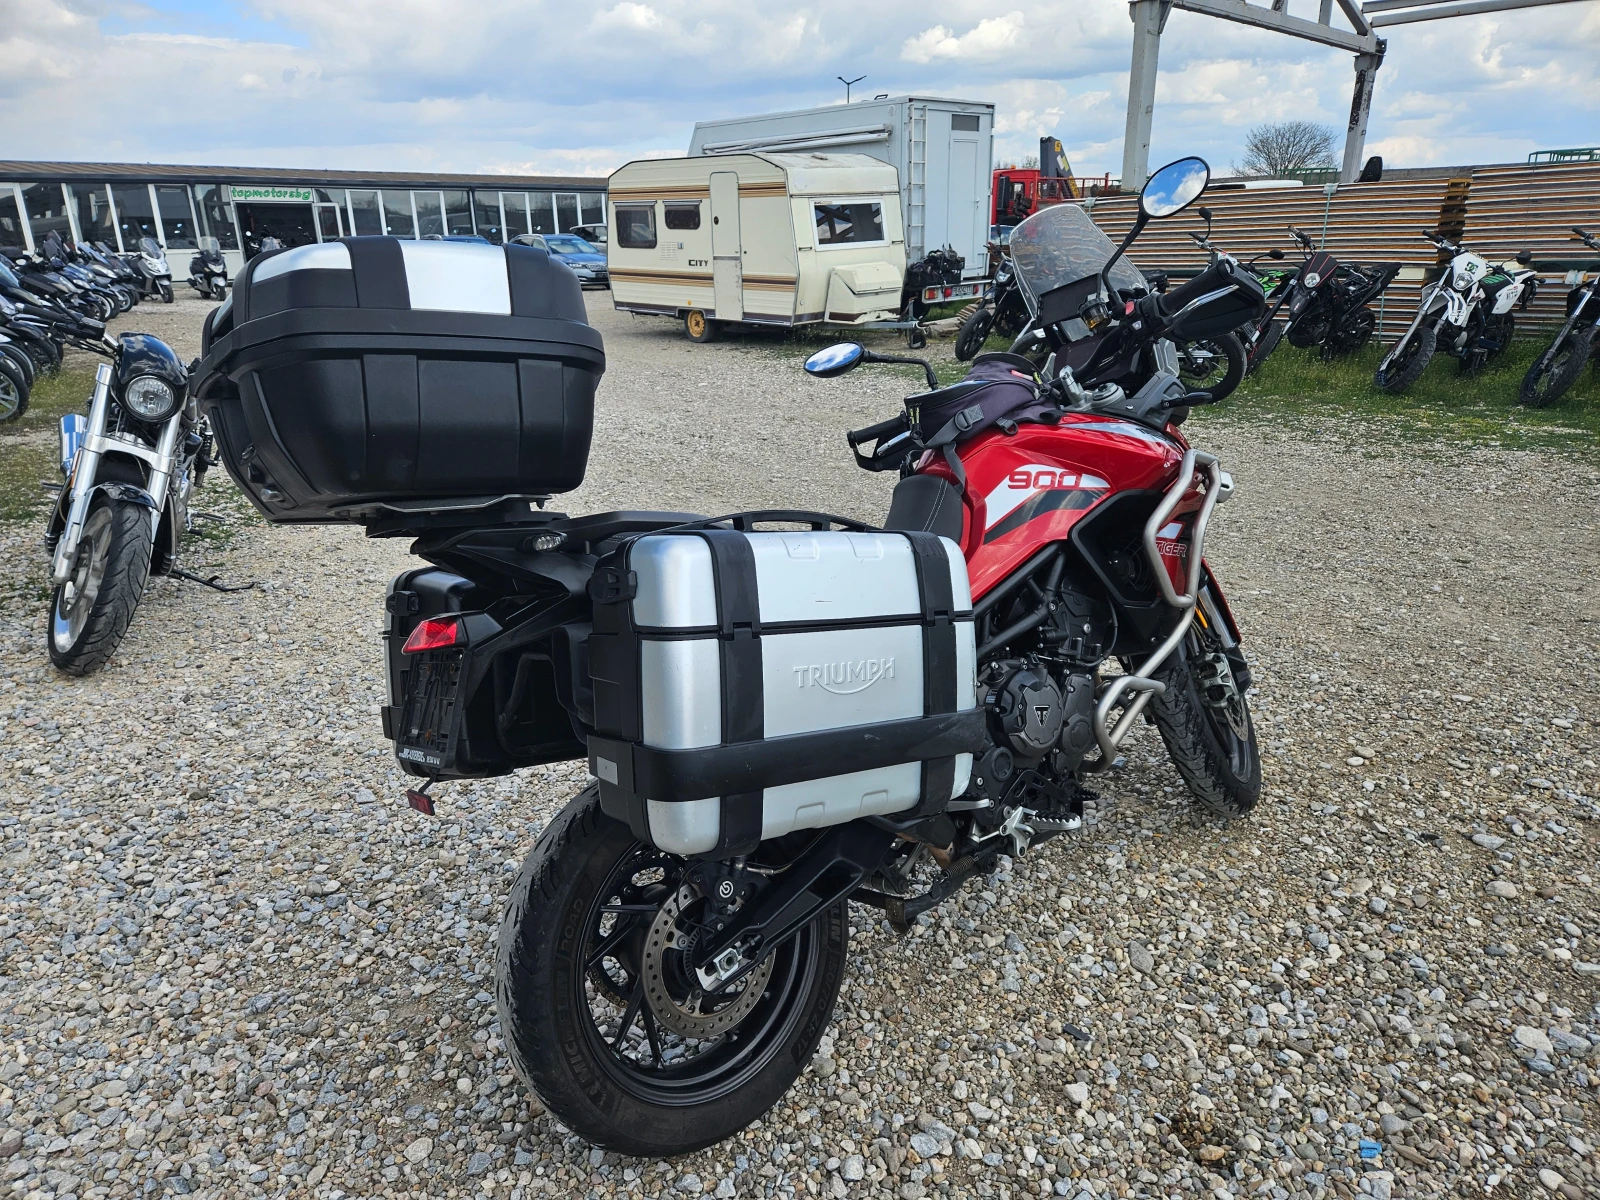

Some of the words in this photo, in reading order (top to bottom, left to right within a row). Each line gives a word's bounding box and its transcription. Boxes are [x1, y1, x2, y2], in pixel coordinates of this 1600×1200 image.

[688, 259, 708, 267] CITY
[1008, 470, 1081, 490] 900
[1155, 540, 1188, 557] TIGER
[793, 657, 896, 695] TRIUMPH
